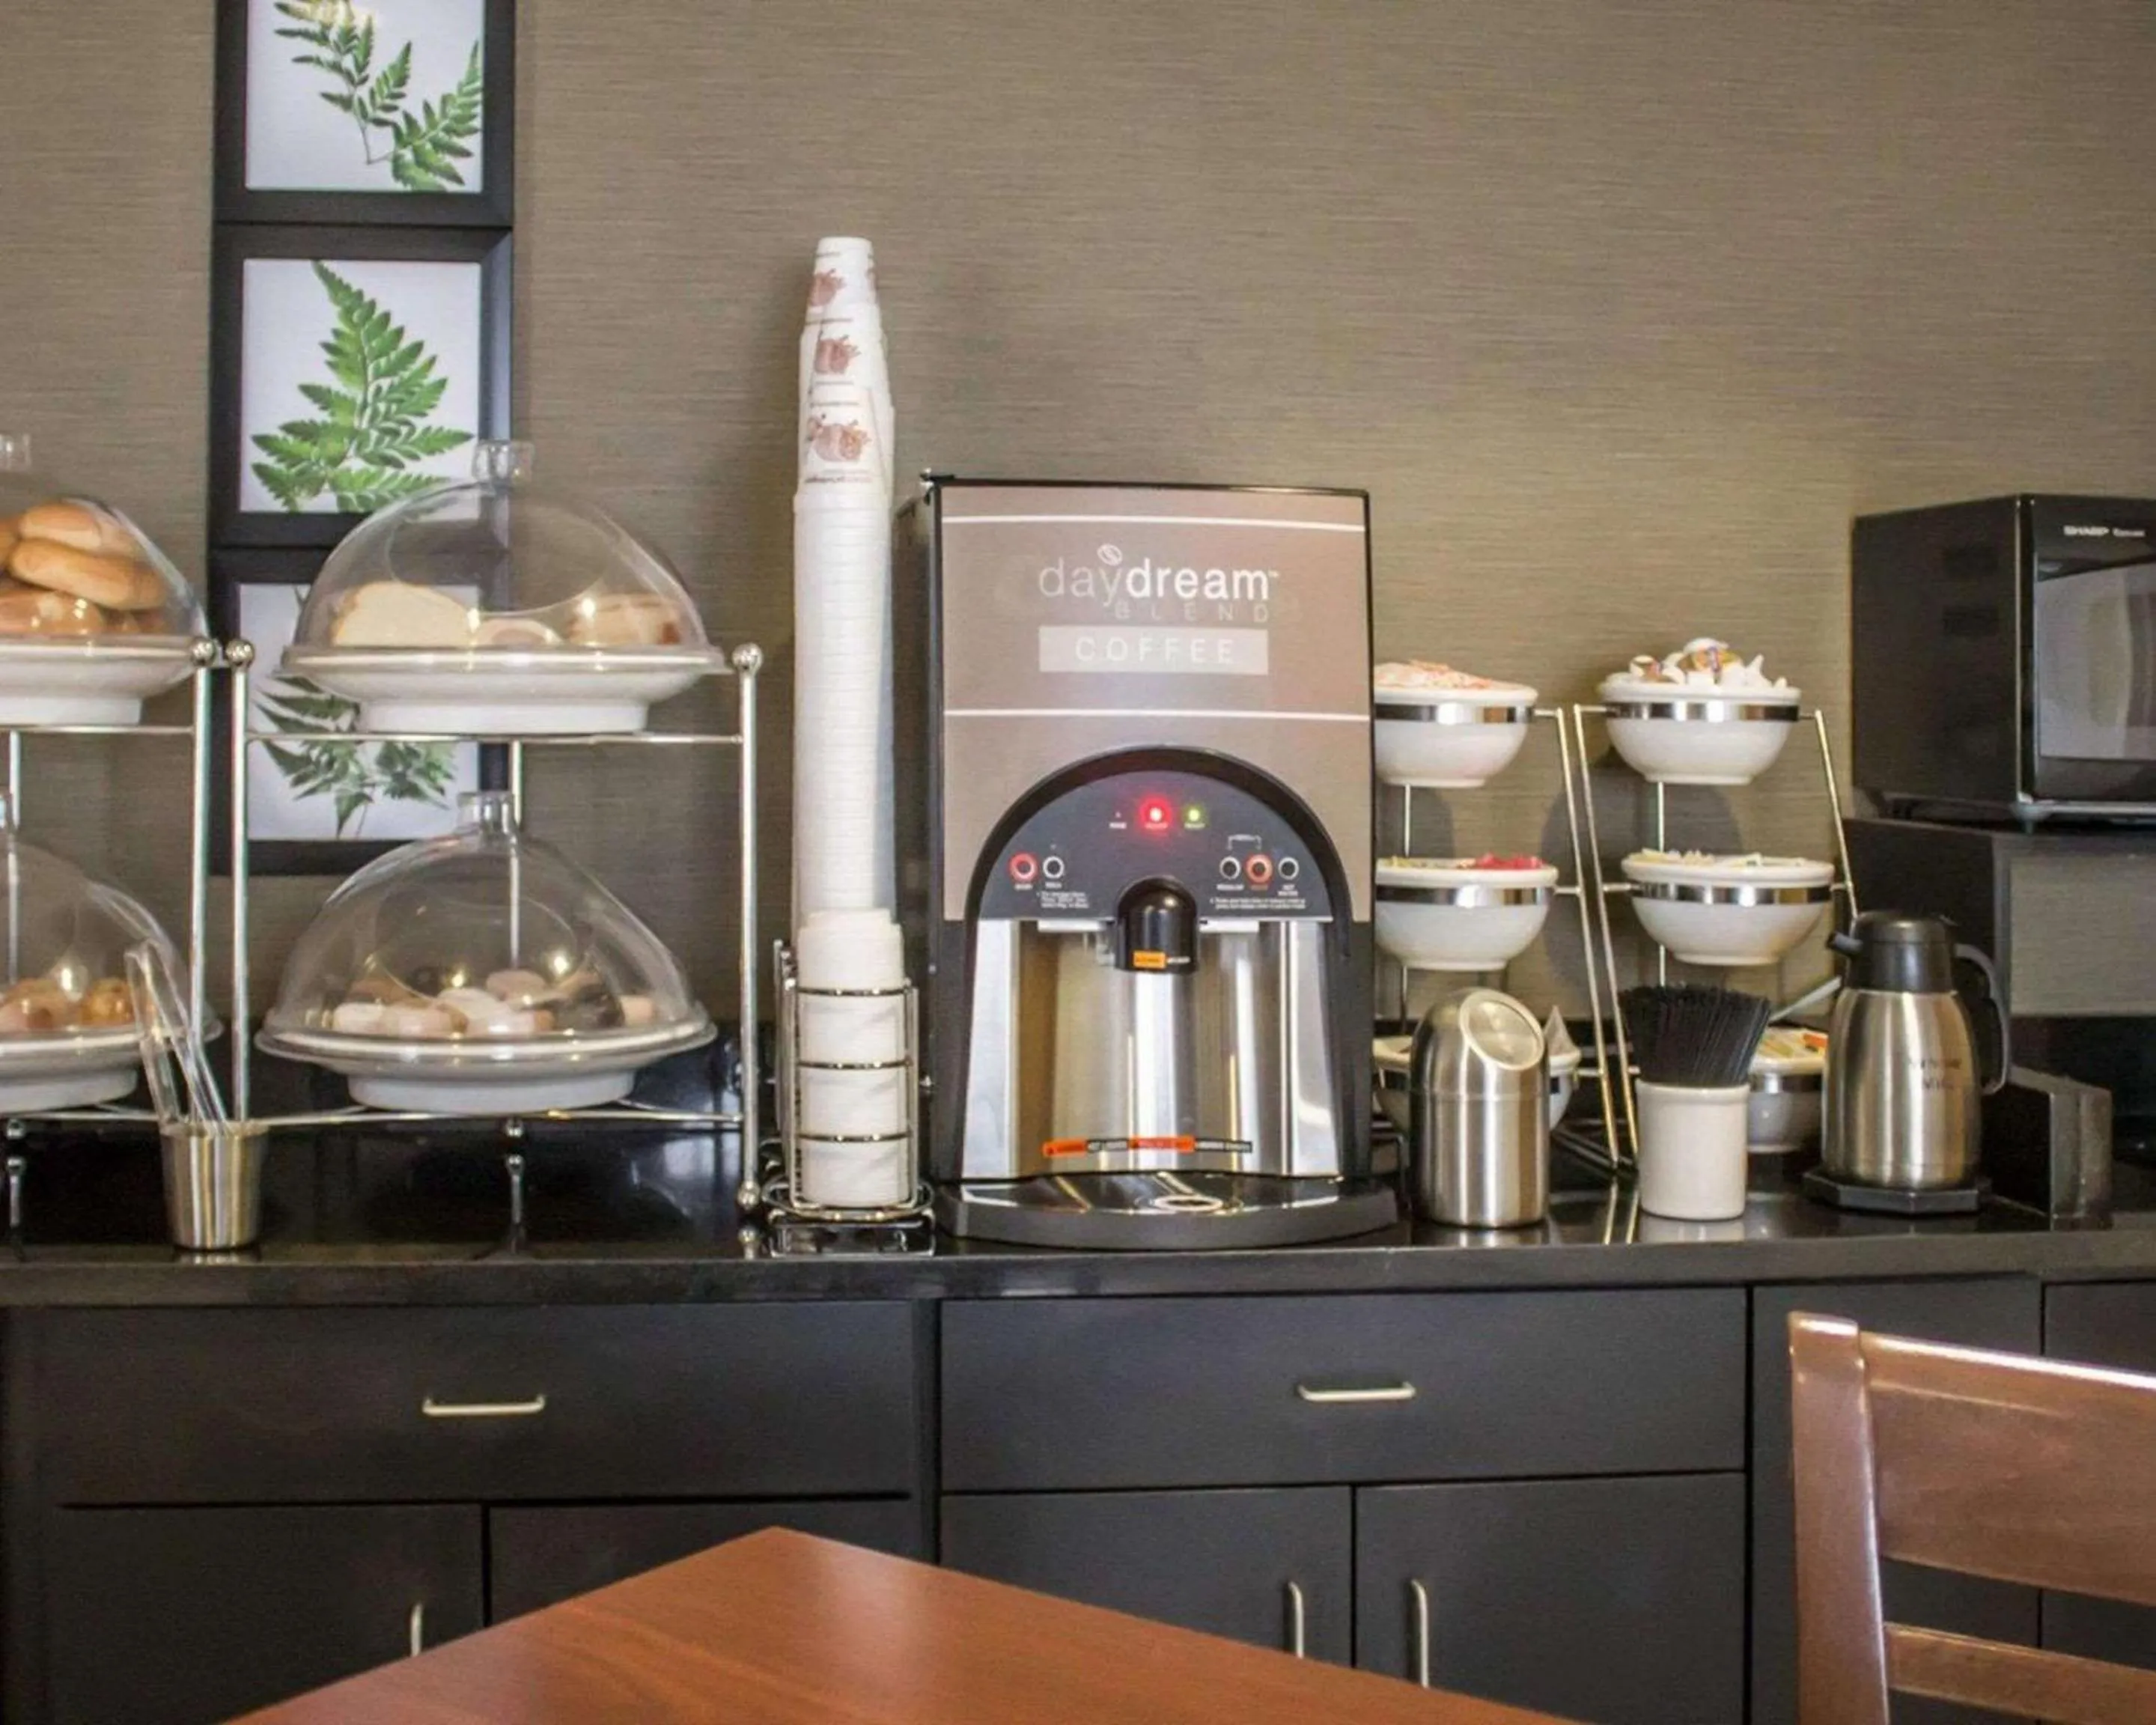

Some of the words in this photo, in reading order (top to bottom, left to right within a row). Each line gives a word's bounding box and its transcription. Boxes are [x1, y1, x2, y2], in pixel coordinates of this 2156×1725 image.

[1038, 557, 1269, 606] daydream
[1115, 601, 1270, 623] BLEND
[1075, 636, 1234, 663] COFFEE
